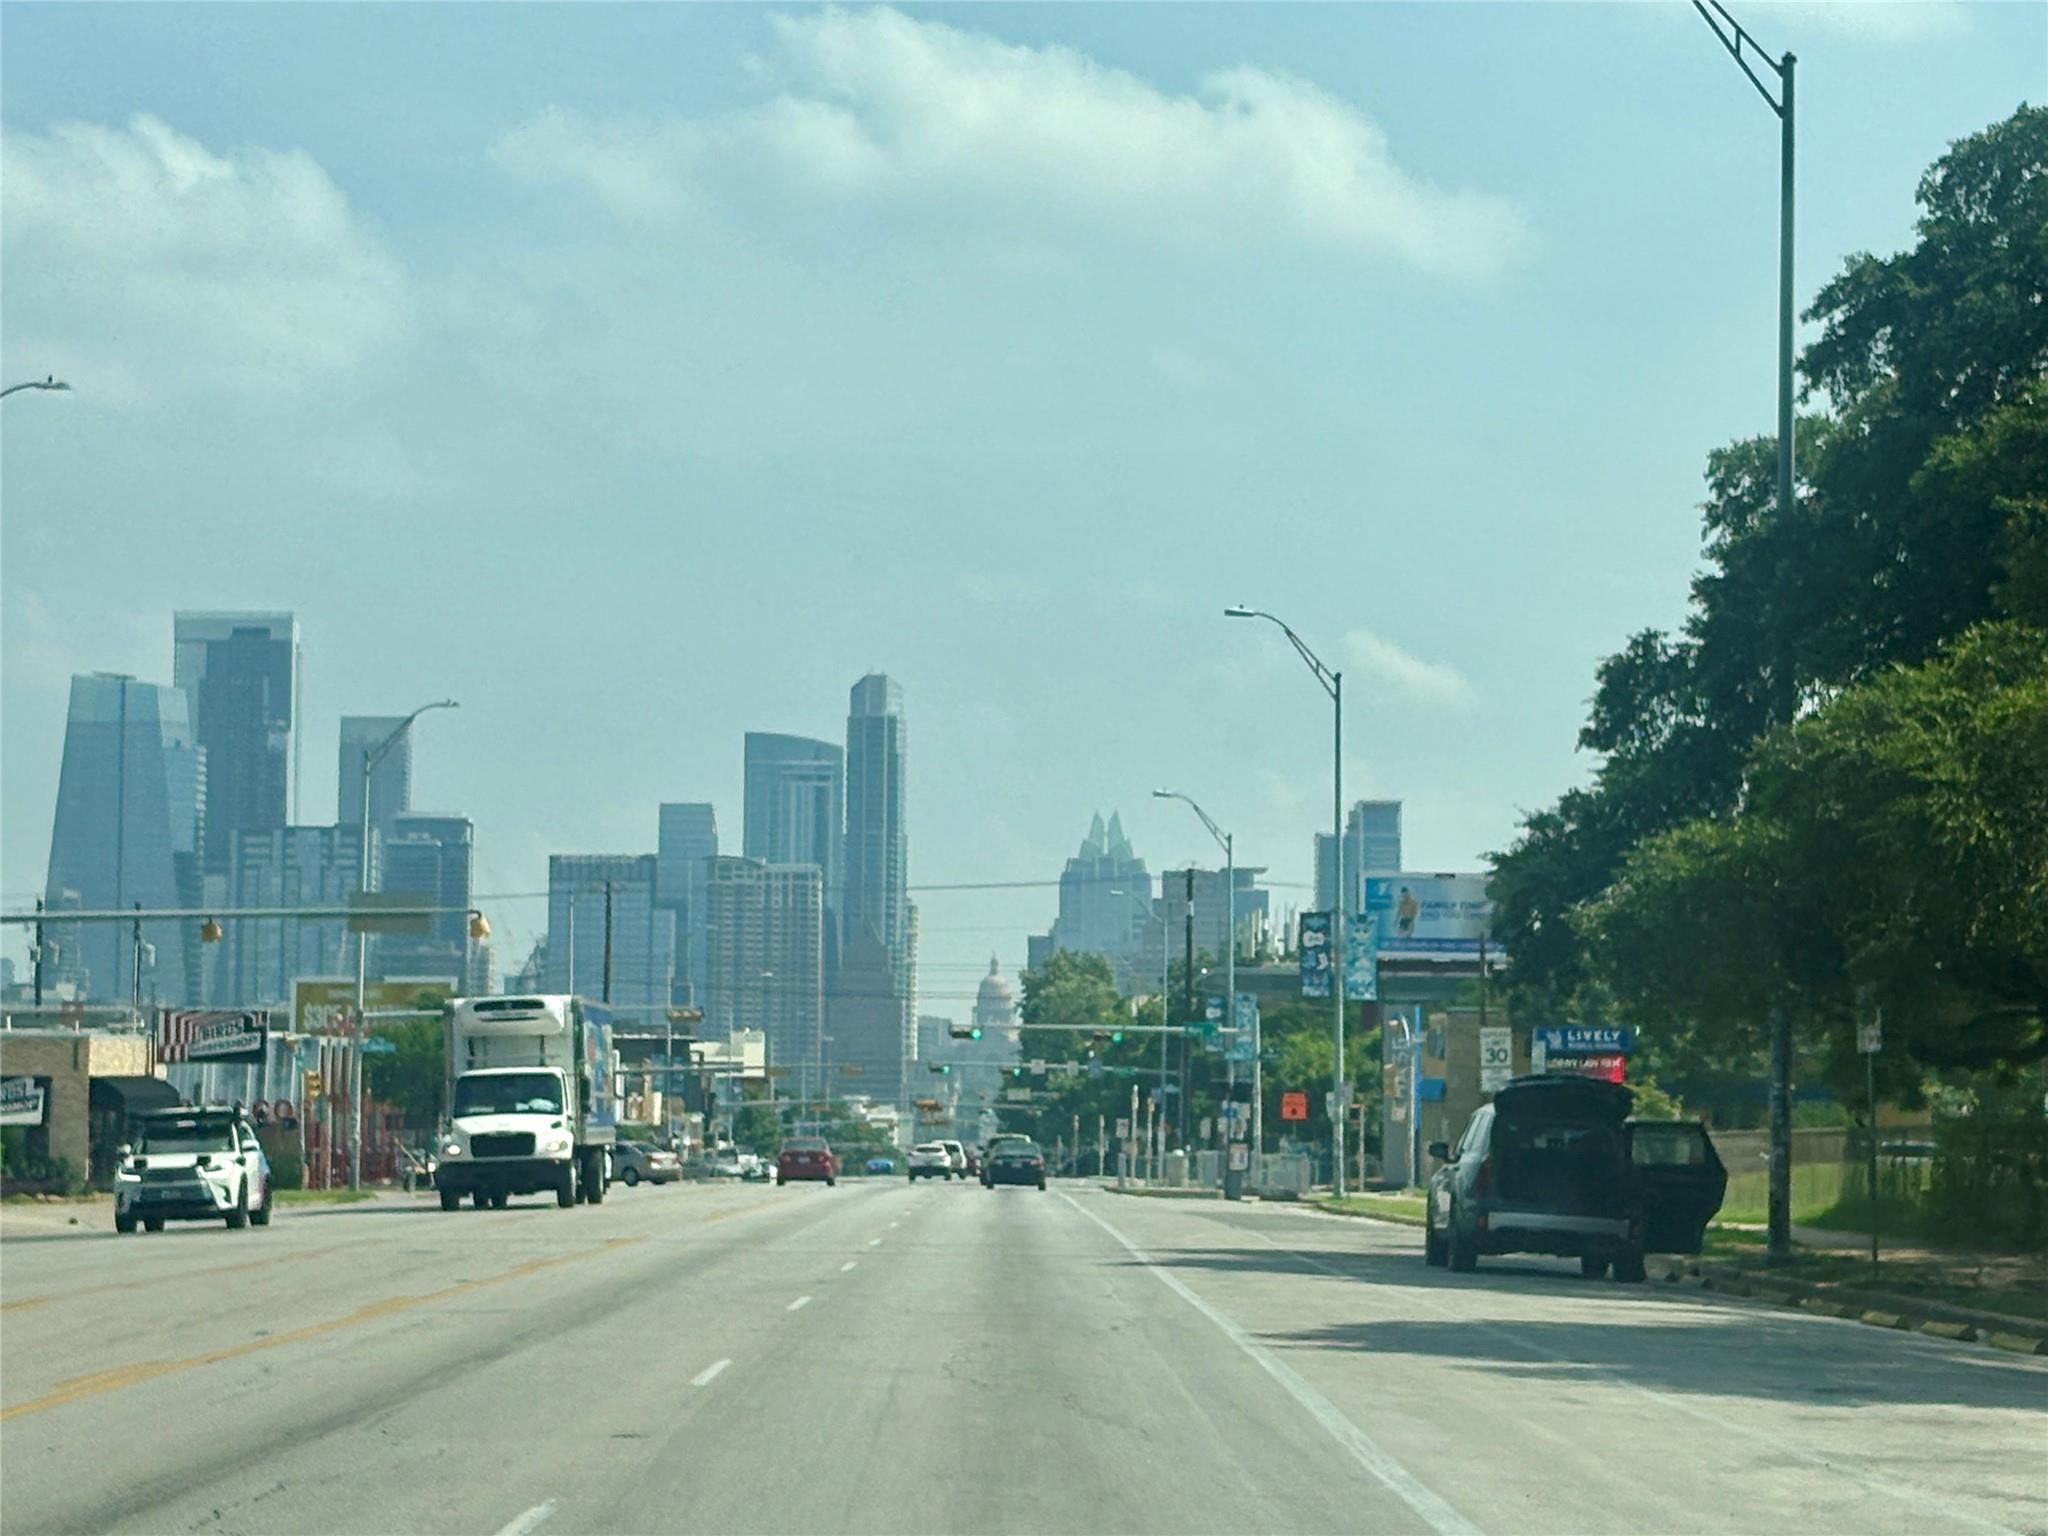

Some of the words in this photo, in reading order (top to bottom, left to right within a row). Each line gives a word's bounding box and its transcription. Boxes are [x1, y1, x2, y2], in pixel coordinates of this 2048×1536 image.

[201, 1019, 243, 1040] BIRDS
[1567, 1030, 1621, 1041] LIVELY
[1485, 1047, 1508, 1063] 30
